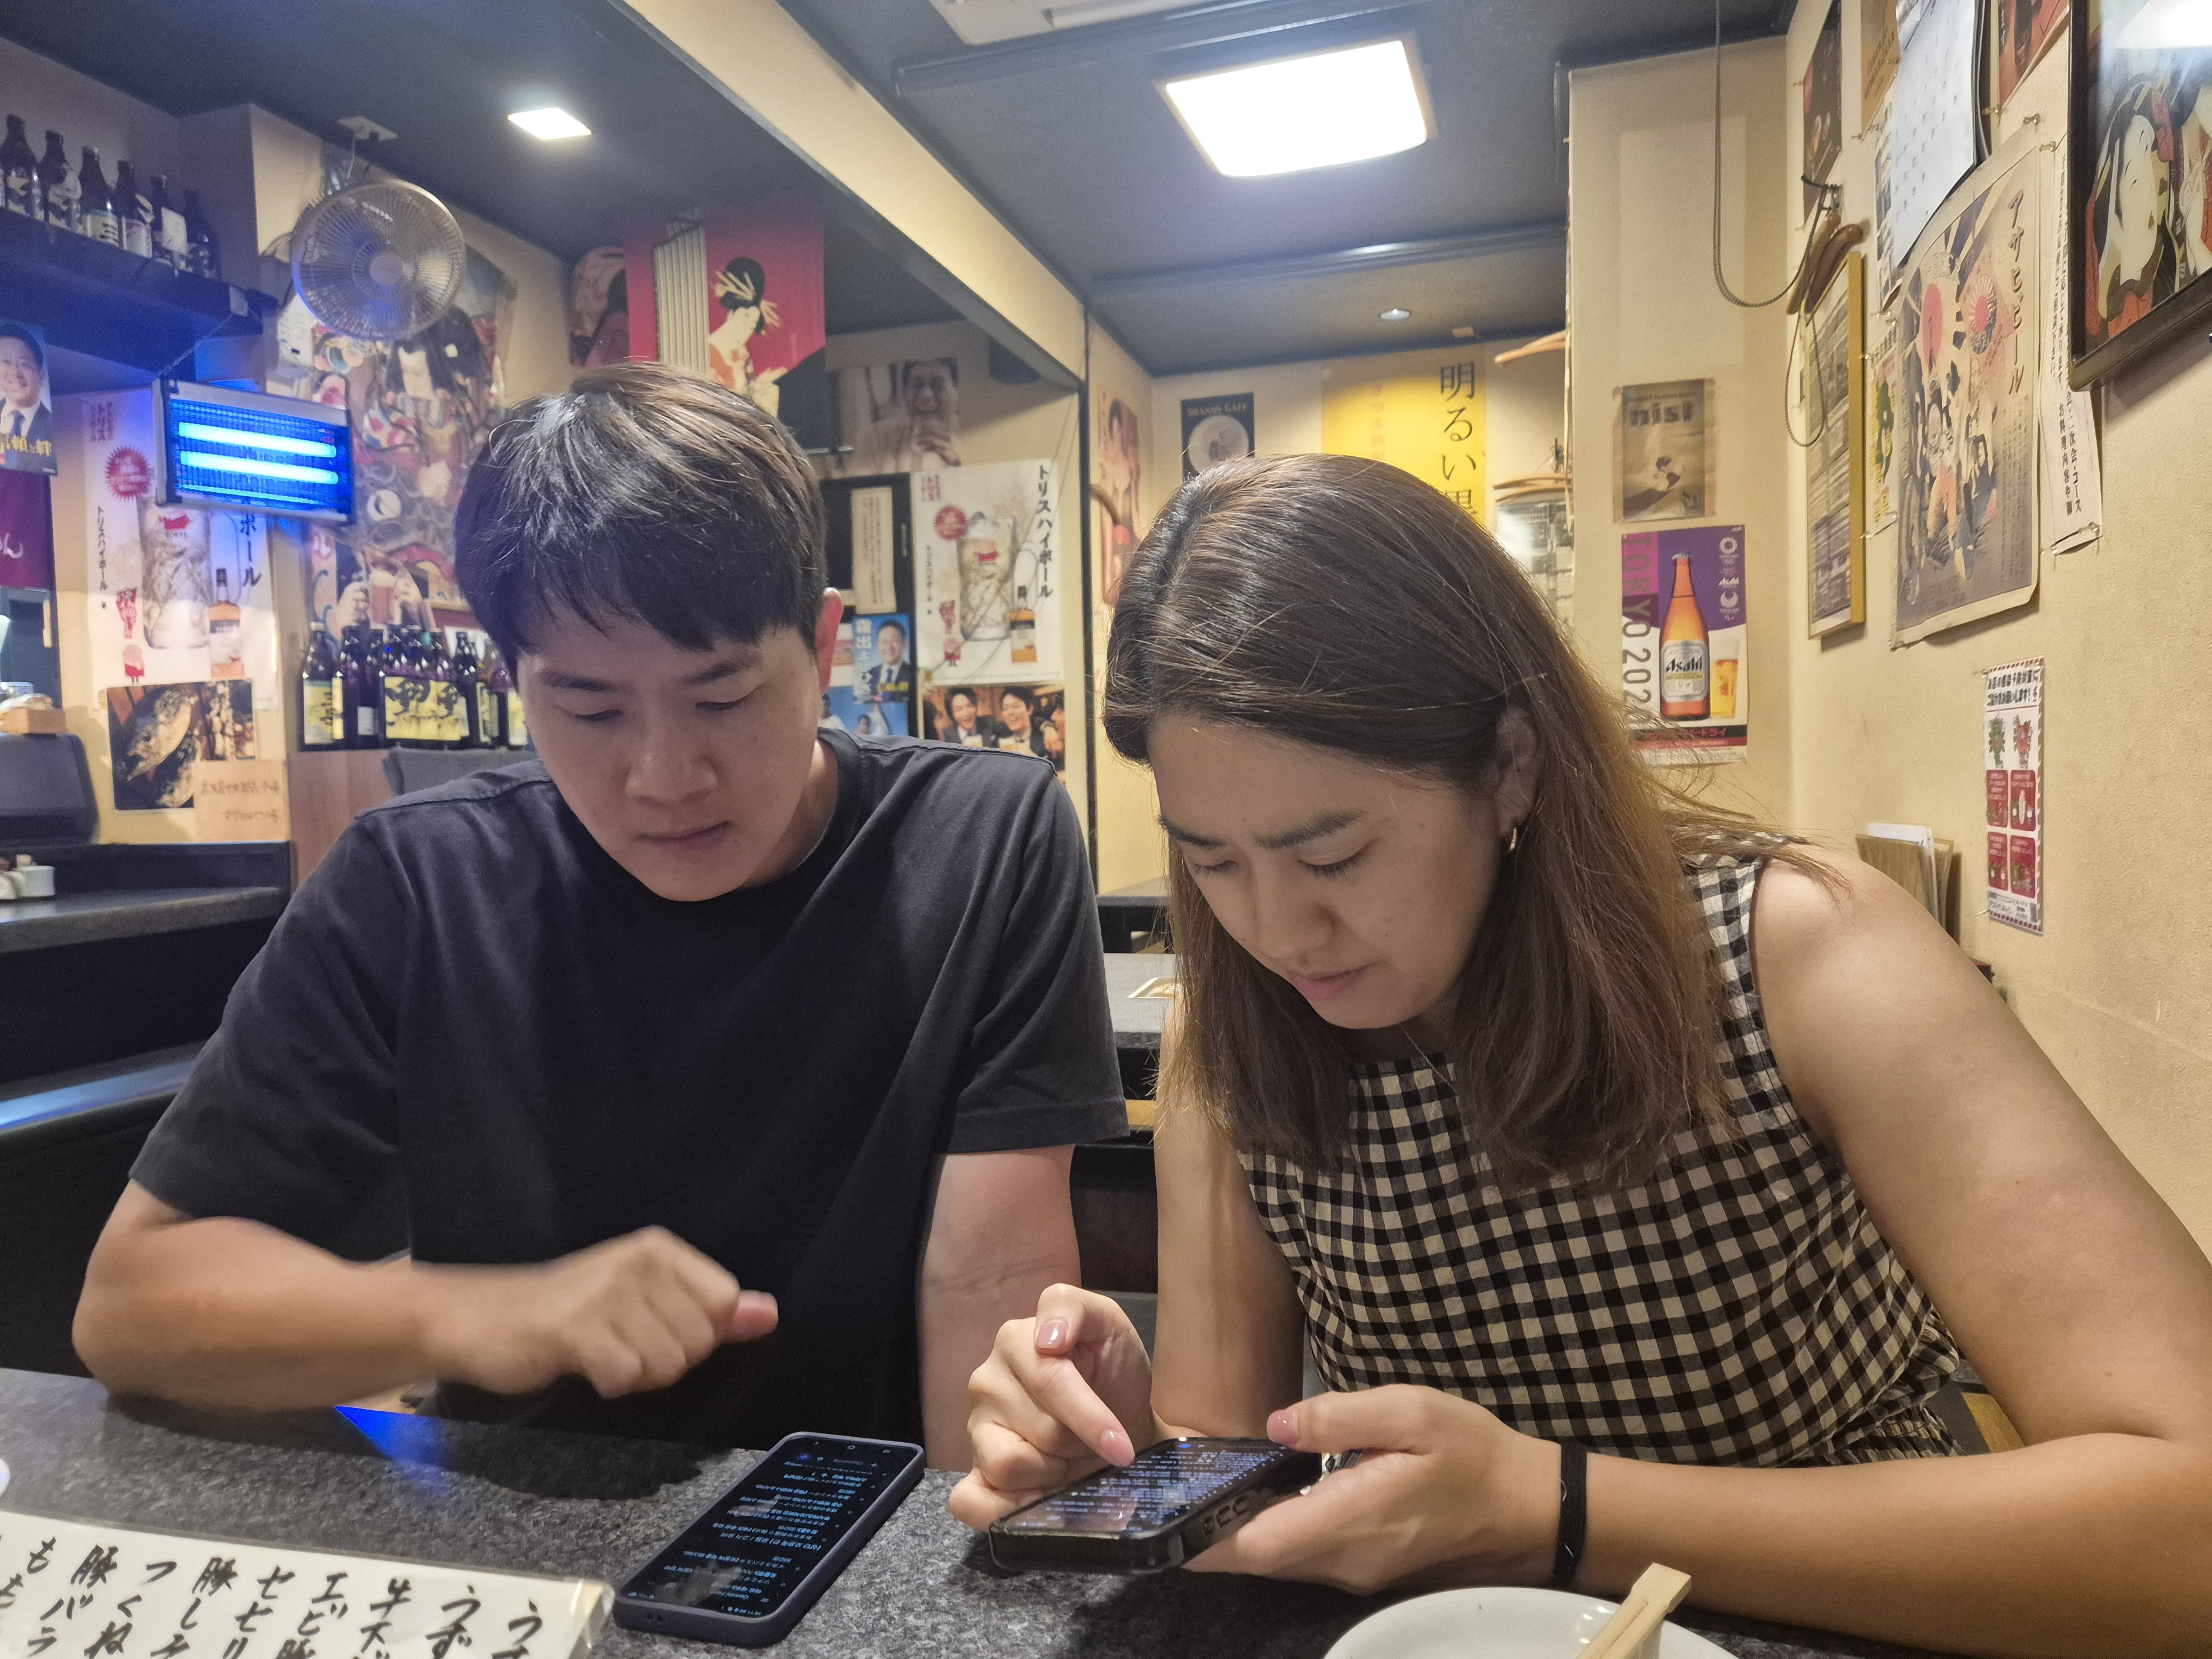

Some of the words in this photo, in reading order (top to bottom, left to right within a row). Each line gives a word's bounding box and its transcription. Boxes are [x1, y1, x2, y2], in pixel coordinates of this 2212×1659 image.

[2007, 189, 2024, 395] アサヒビール
[1036, 465, 1053, 598] トリスハイボール
[1622, 532, 1651, 638] TOKYO
[1623, 648, 1653, 722] 202
[1666, 655, 1703, 672] Asahi
[27, 1544, 119, 1658] 豚バラ
[491, 1600, 543, 1659] う
